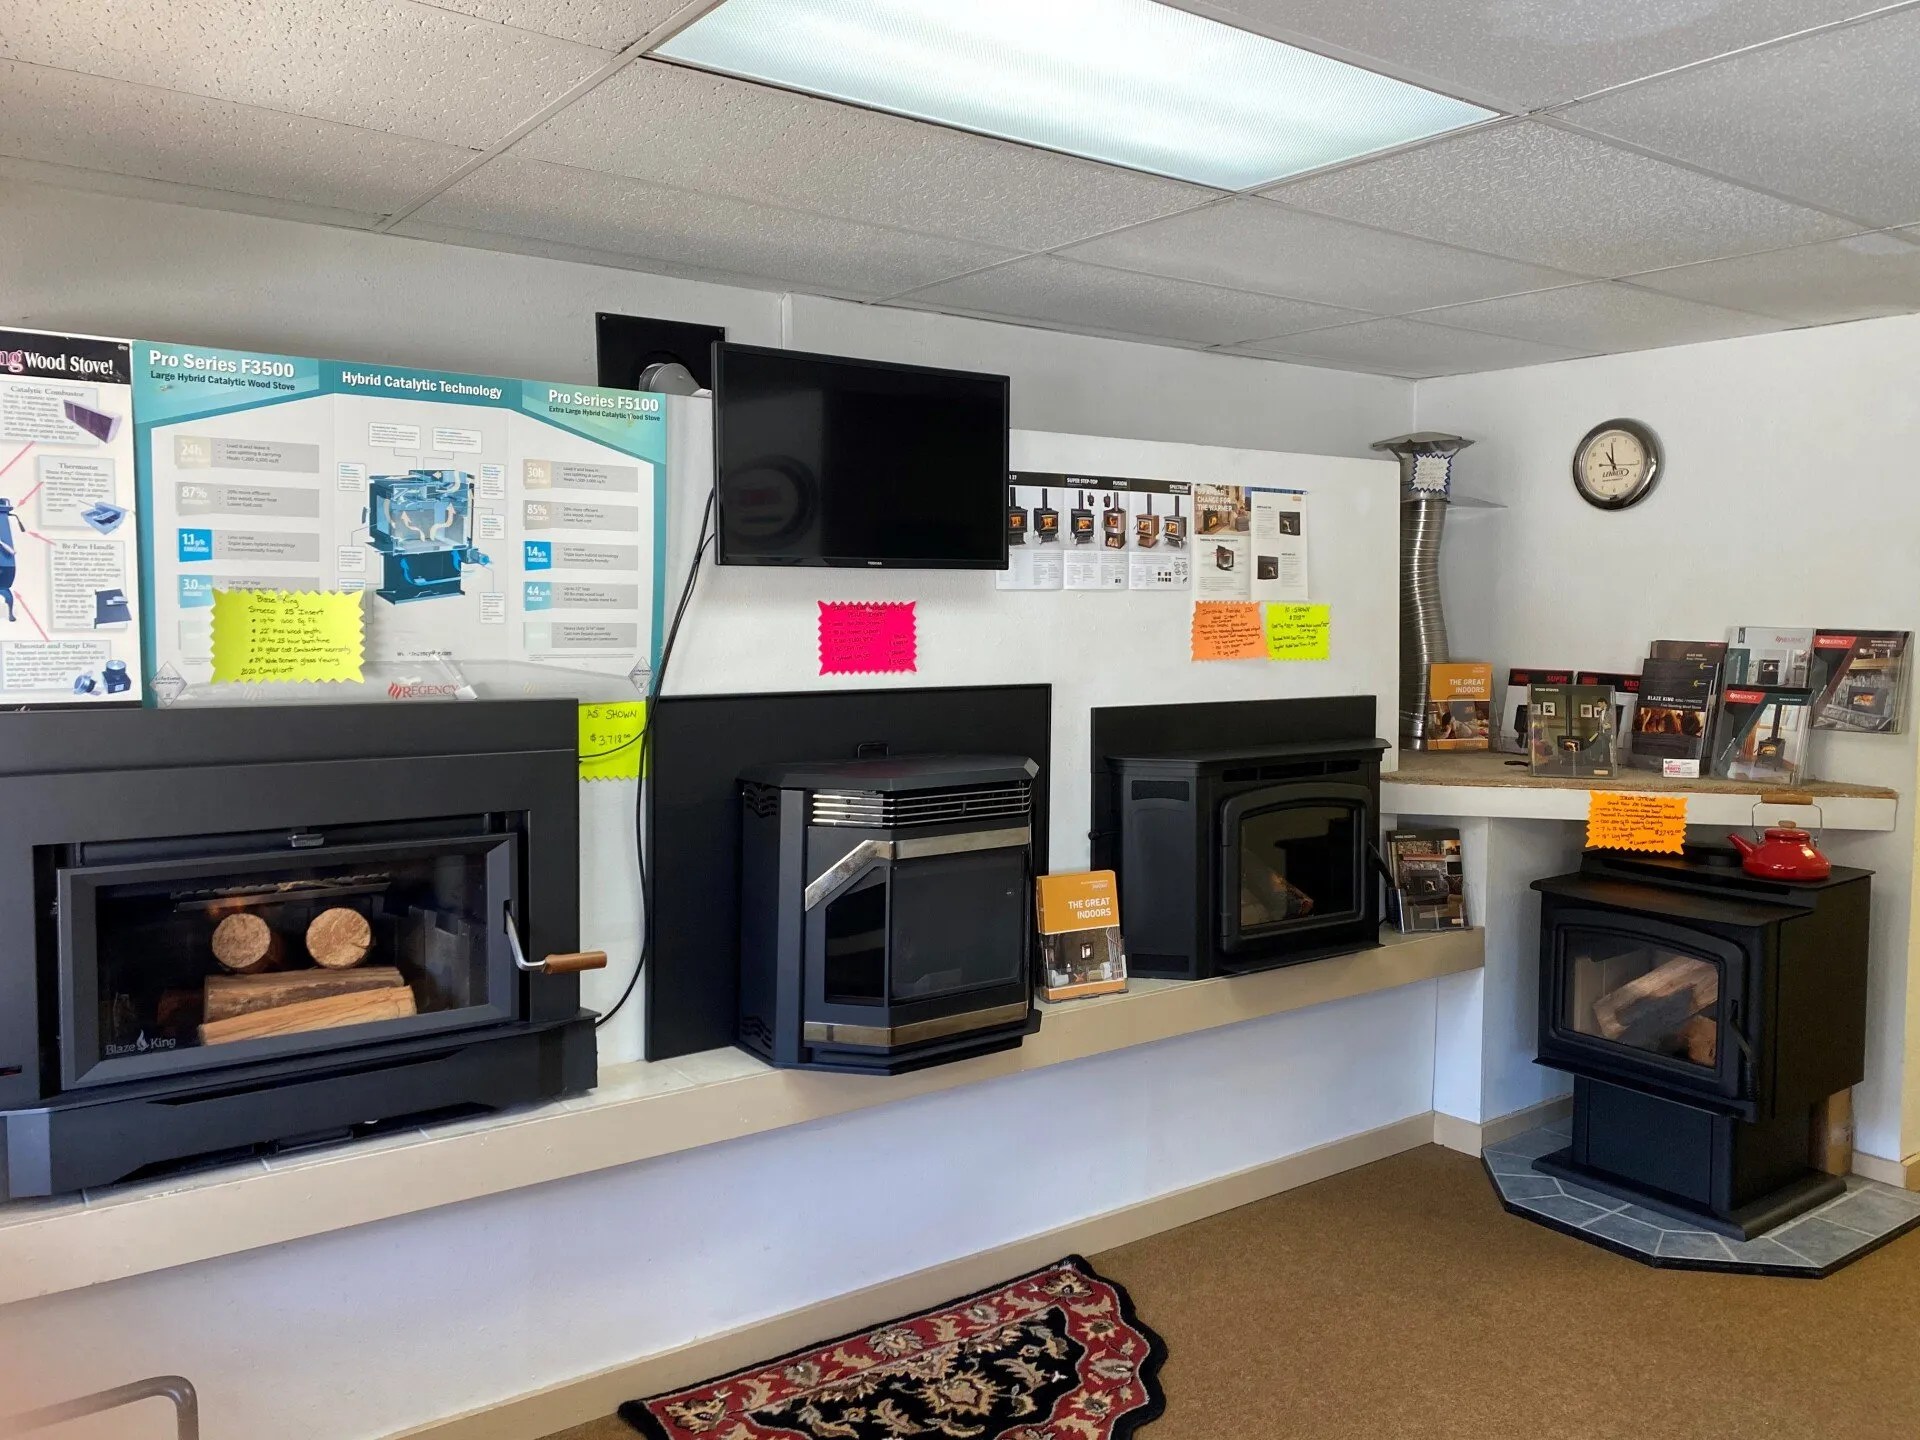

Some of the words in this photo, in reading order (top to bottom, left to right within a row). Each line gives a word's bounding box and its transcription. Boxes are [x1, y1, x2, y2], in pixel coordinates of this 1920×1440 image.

[24, 351, 66, 371] Wood
[69, 355, 114, 375] Stove!
[149, 350, 178, 368] Pro
[183, 353, 237, 373] Series
[241, 358, 295, 378] F3500
[150, 370, 175, 382] Large
[177, 372, 206, 383] Hybrid
[208, 375, 246, 387] Catalytic
[247, 378, 271, 389] Wood
[272, 381, 296, 391] Stove
[342, 371, 381, 386] Hybrid
[384, 375, 437, 392] Catalytic
[439, 380, 502, 399] Technology
[548, 389, 571, 404] Pro
[574, 392, 615, 408] Series
[617, 396, 660, 412] F5100
[548, 405, 565, 414] Extra
[565, 407, 582, 416] Large
[582, 408, 601, 417] Hybrid
[601, 410, 627, 419] Catalytic
[644, 414, 661, 422] Stove
[527, 504, 547, 515] 85%
[298, 608, 325, 616] Insert
[402, 684, 459, 698] REGENCY
[586, 709, 599, 719] AS
[606, 709, 638, 720] SHOWN
[1068, 900, 1083, 910] THE
[1085, 897, 1110, 908] GREAT
[1077, 908, 1111, 919] INDOORS
[105, 1043, 136, 1056] Blaze
[150, 1038, 176, 1049] King
